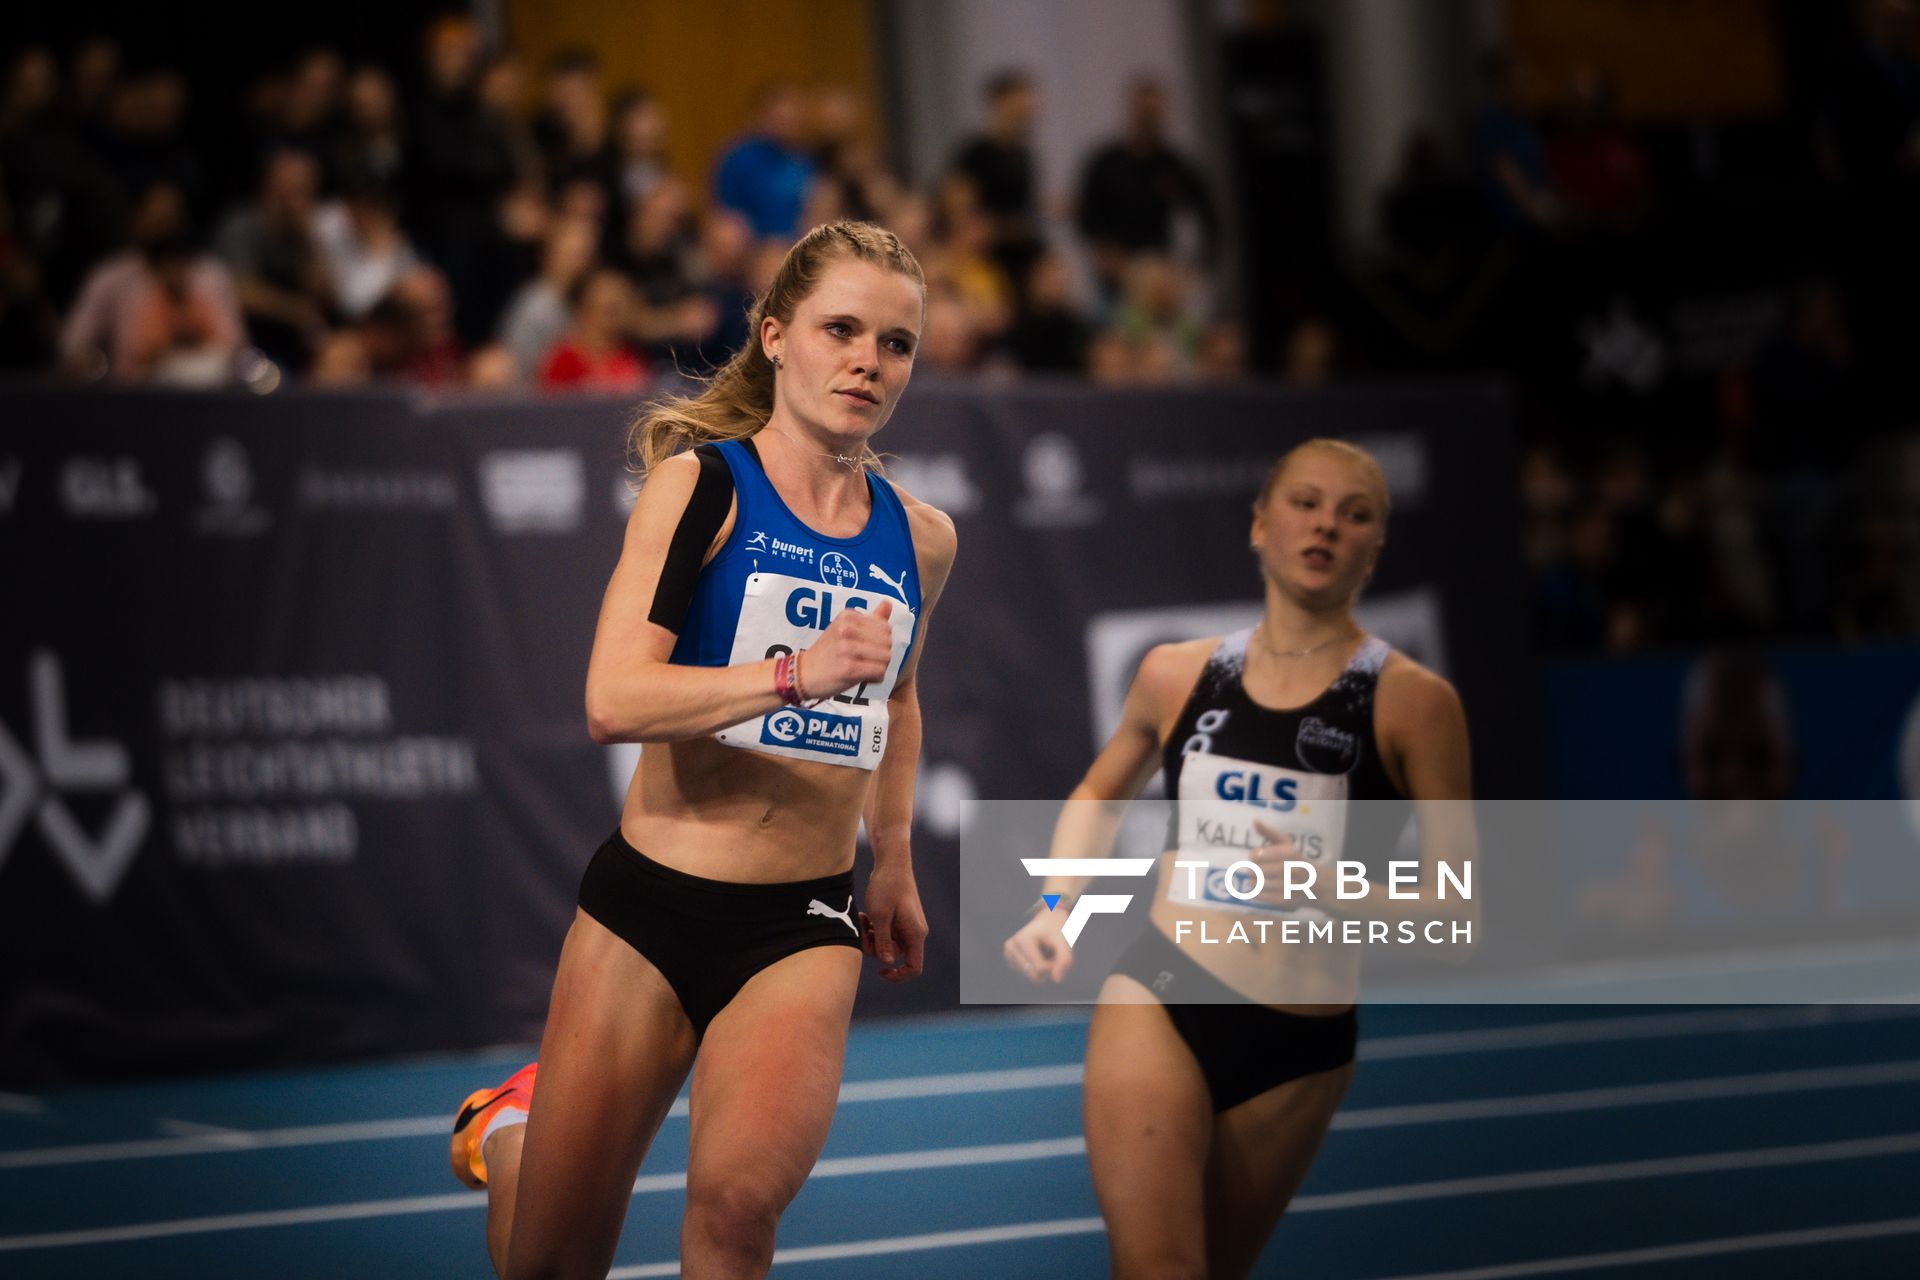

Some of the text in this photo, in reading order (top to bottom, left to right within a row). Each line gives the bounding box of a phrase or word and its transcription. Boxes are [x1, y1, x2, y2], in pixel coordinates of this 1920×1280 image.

[771, 538, 814, 559] bunert
[772, 549, 814, 565] NEUSS
[823, 565, 855, 579] BAYER
[806, 718, 859, 742] PLAN
[805, 737, 857, 752] INTERNATIONAL
[871, 726, 882, 753] 303
